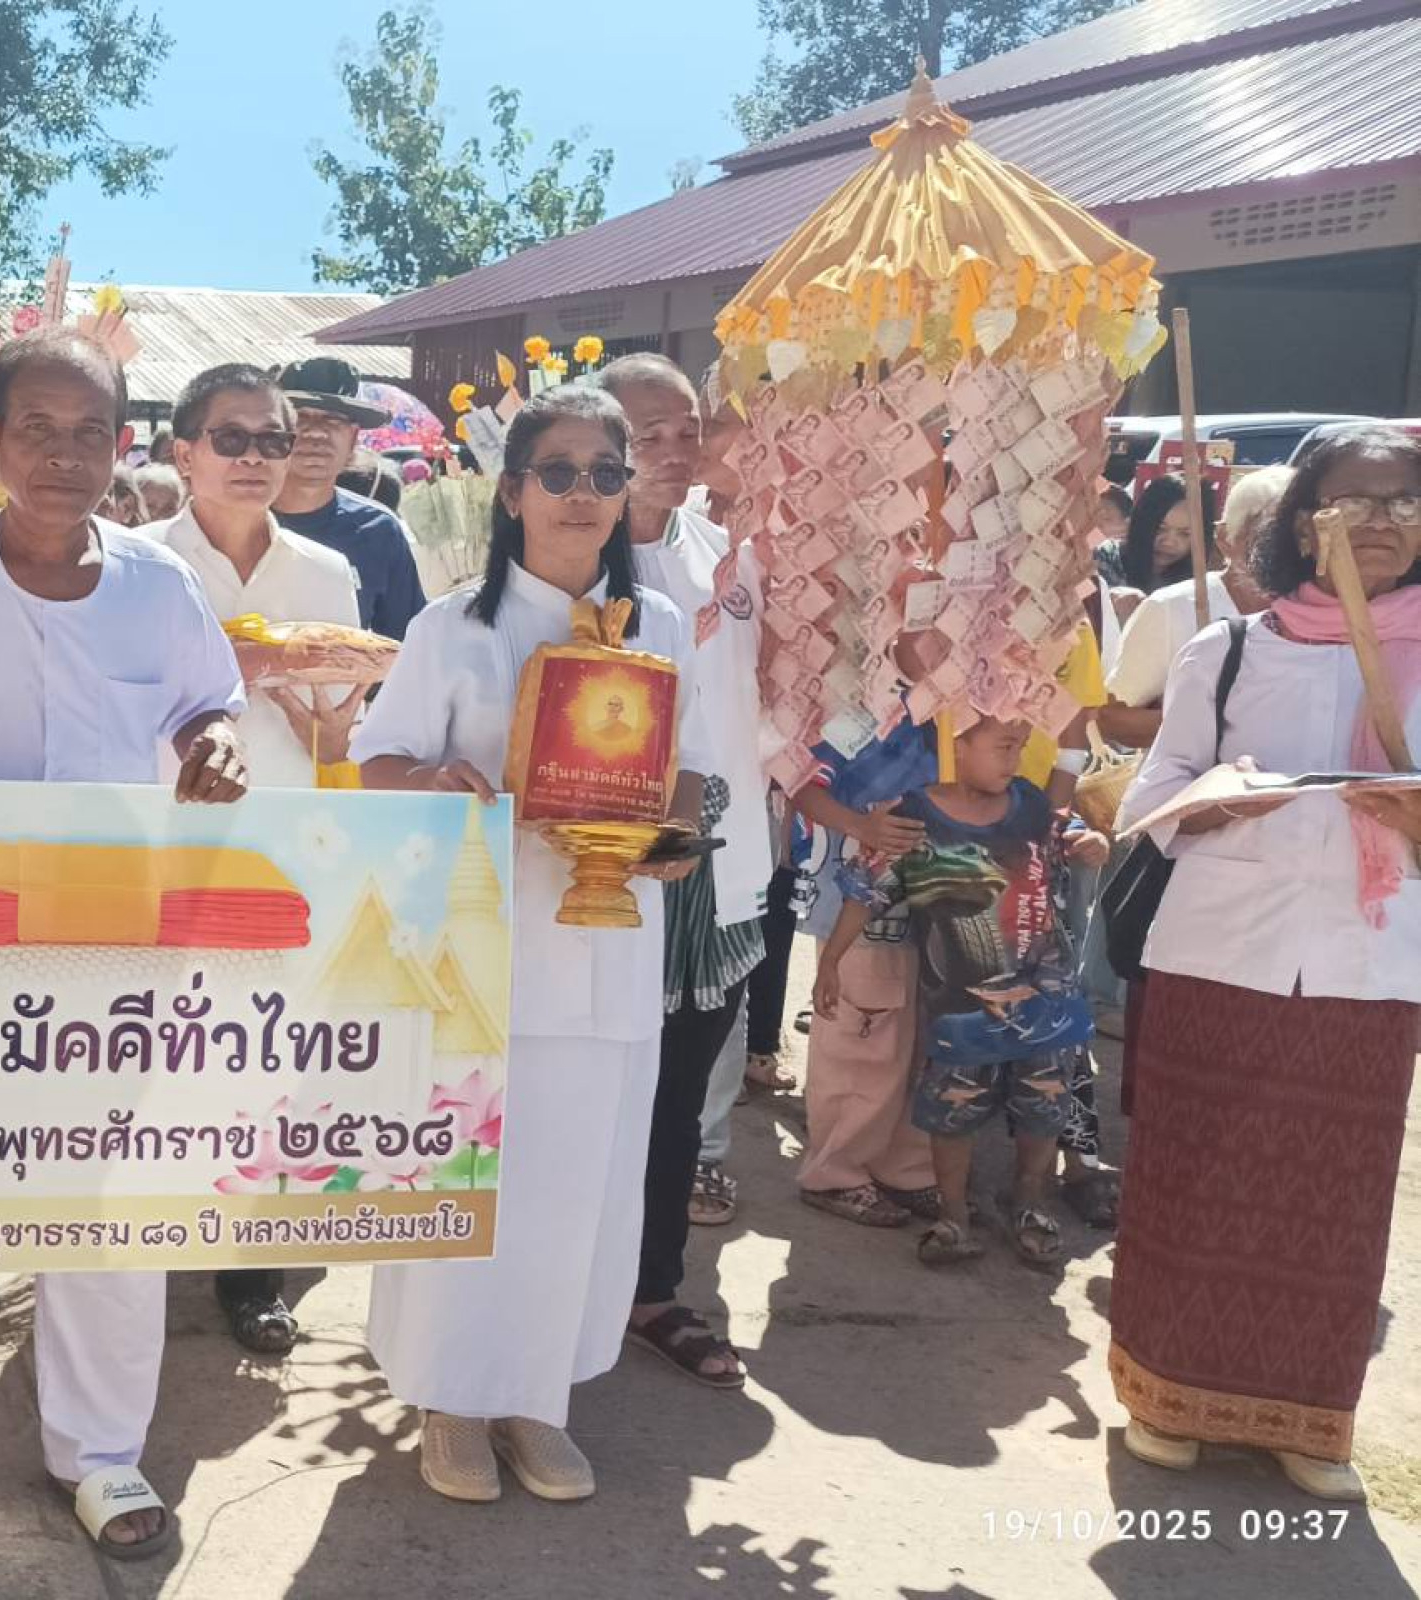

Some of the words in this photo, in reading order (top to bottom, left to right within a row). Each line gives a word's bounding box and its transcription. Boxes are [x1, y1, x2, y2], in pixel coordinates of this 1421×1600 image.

[277, 1113, 454, 1159] ๒๕๖๘
[140, 1220, 188, 1246] ๘๑
[198, 1207, 220, 1245] ปี
[232, 1203, 472, 1244] หลวงพ่อธัมมชโย
